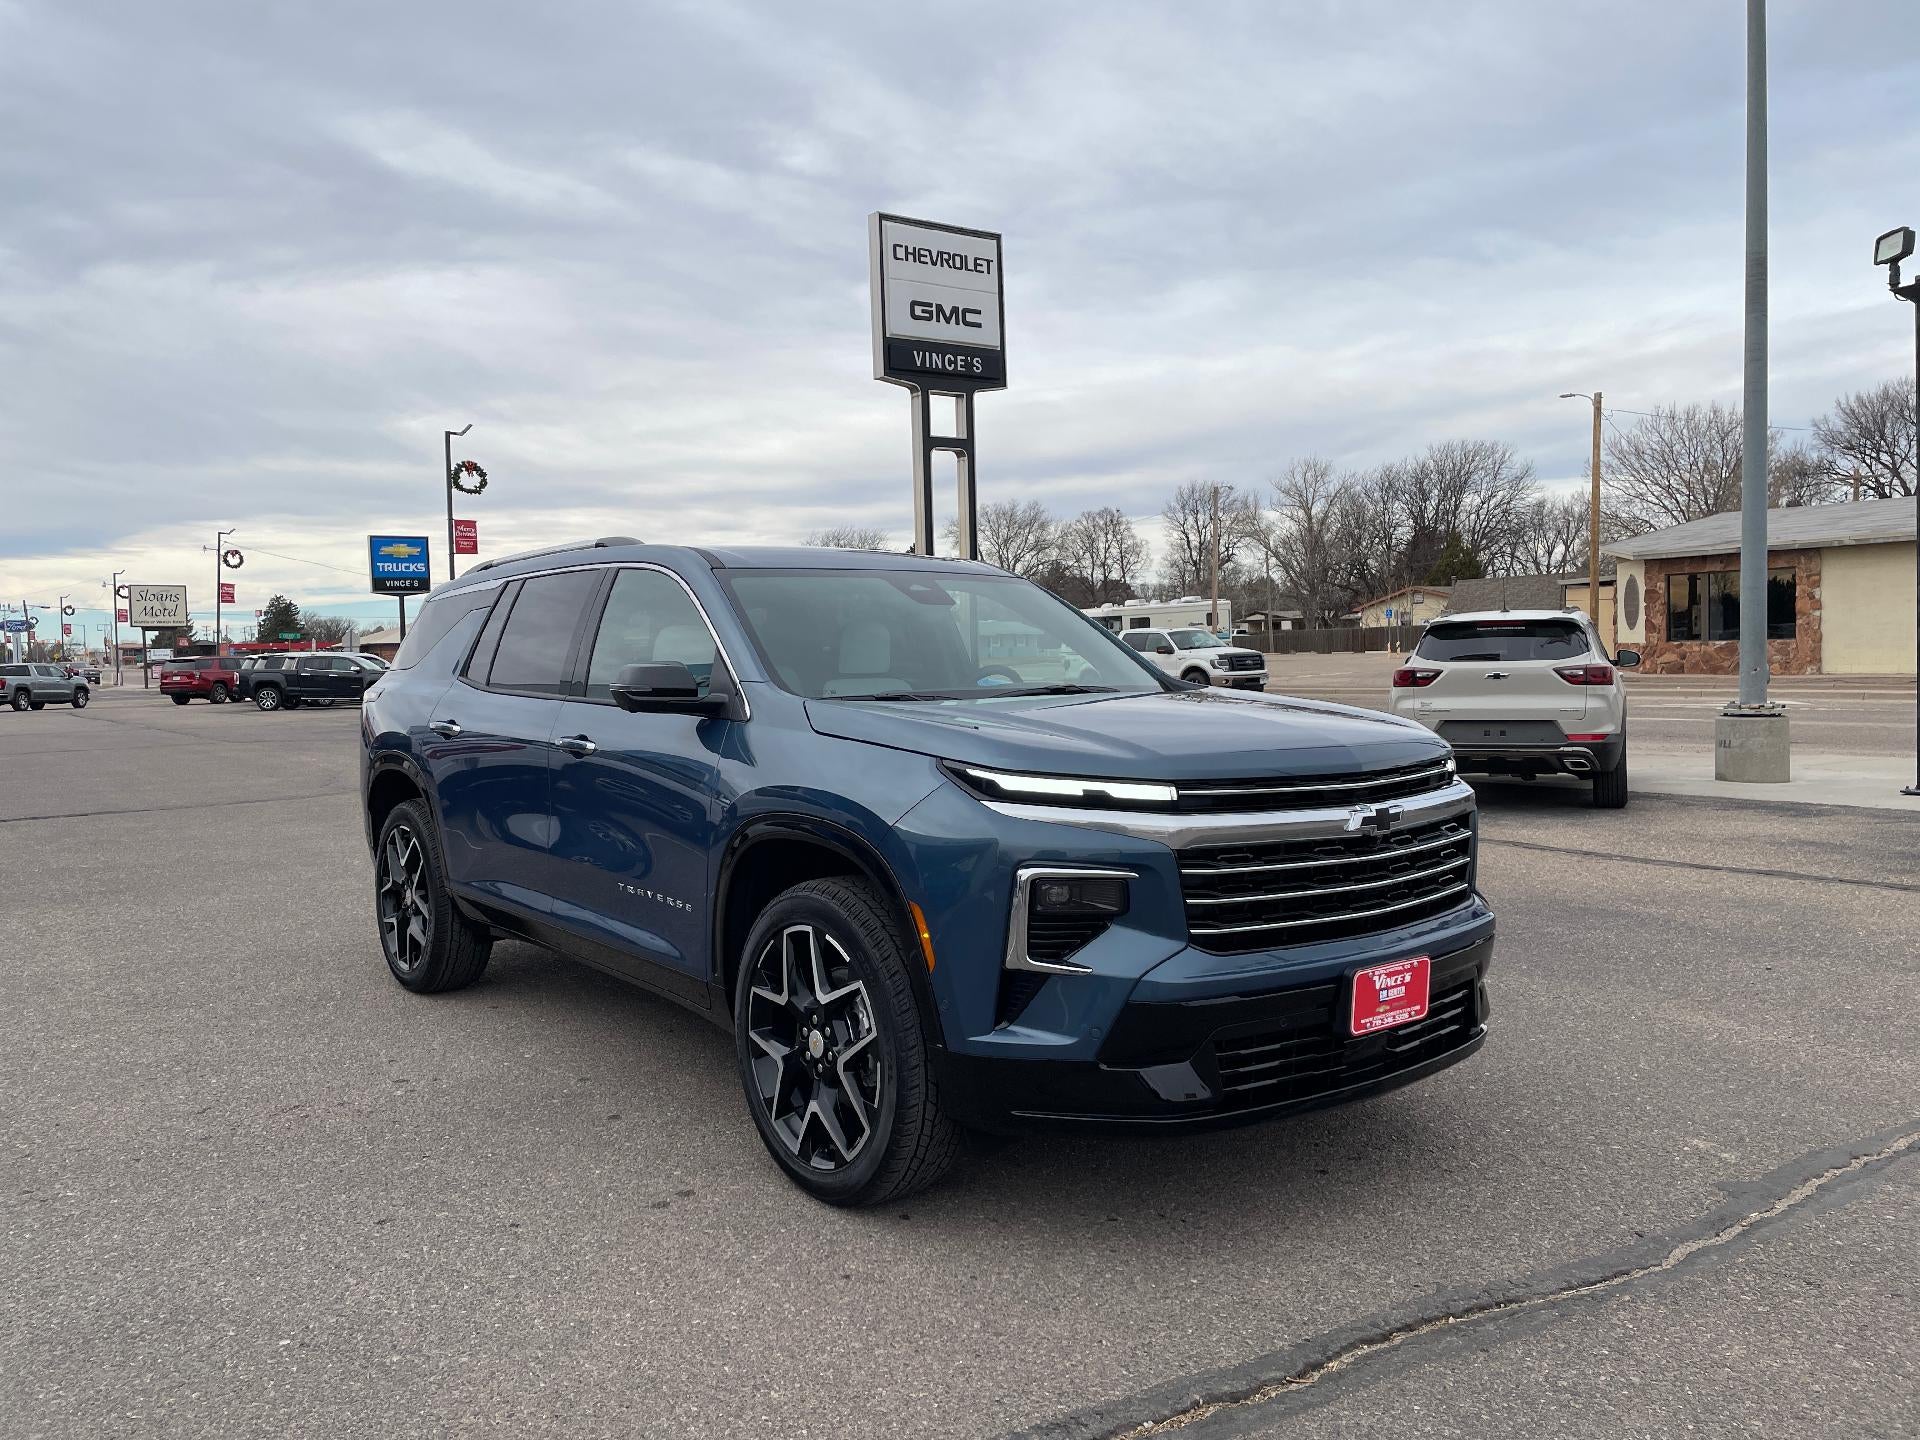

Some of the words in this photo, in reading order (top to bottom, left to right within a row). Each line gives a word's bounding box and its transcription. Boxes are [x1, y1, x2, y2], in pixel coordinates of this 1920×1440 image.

[892, 243, 994, 274] CHEVROLET
[909, 299, 983, 329] GMC
[913, 350, 983, 373] VINCE'S
[376, 562, 426, 572] TRUCKS
[385, 579, 419, 587] VINCE'S
[136, 588, 180, 602] Sloans
[138, 603, 179, 618] Motel
[6, 620, 27, 631] Ford
[617, 882, 693, 912] TRAVERSE
[1372, 972, 1413, 990] VINCE'S
